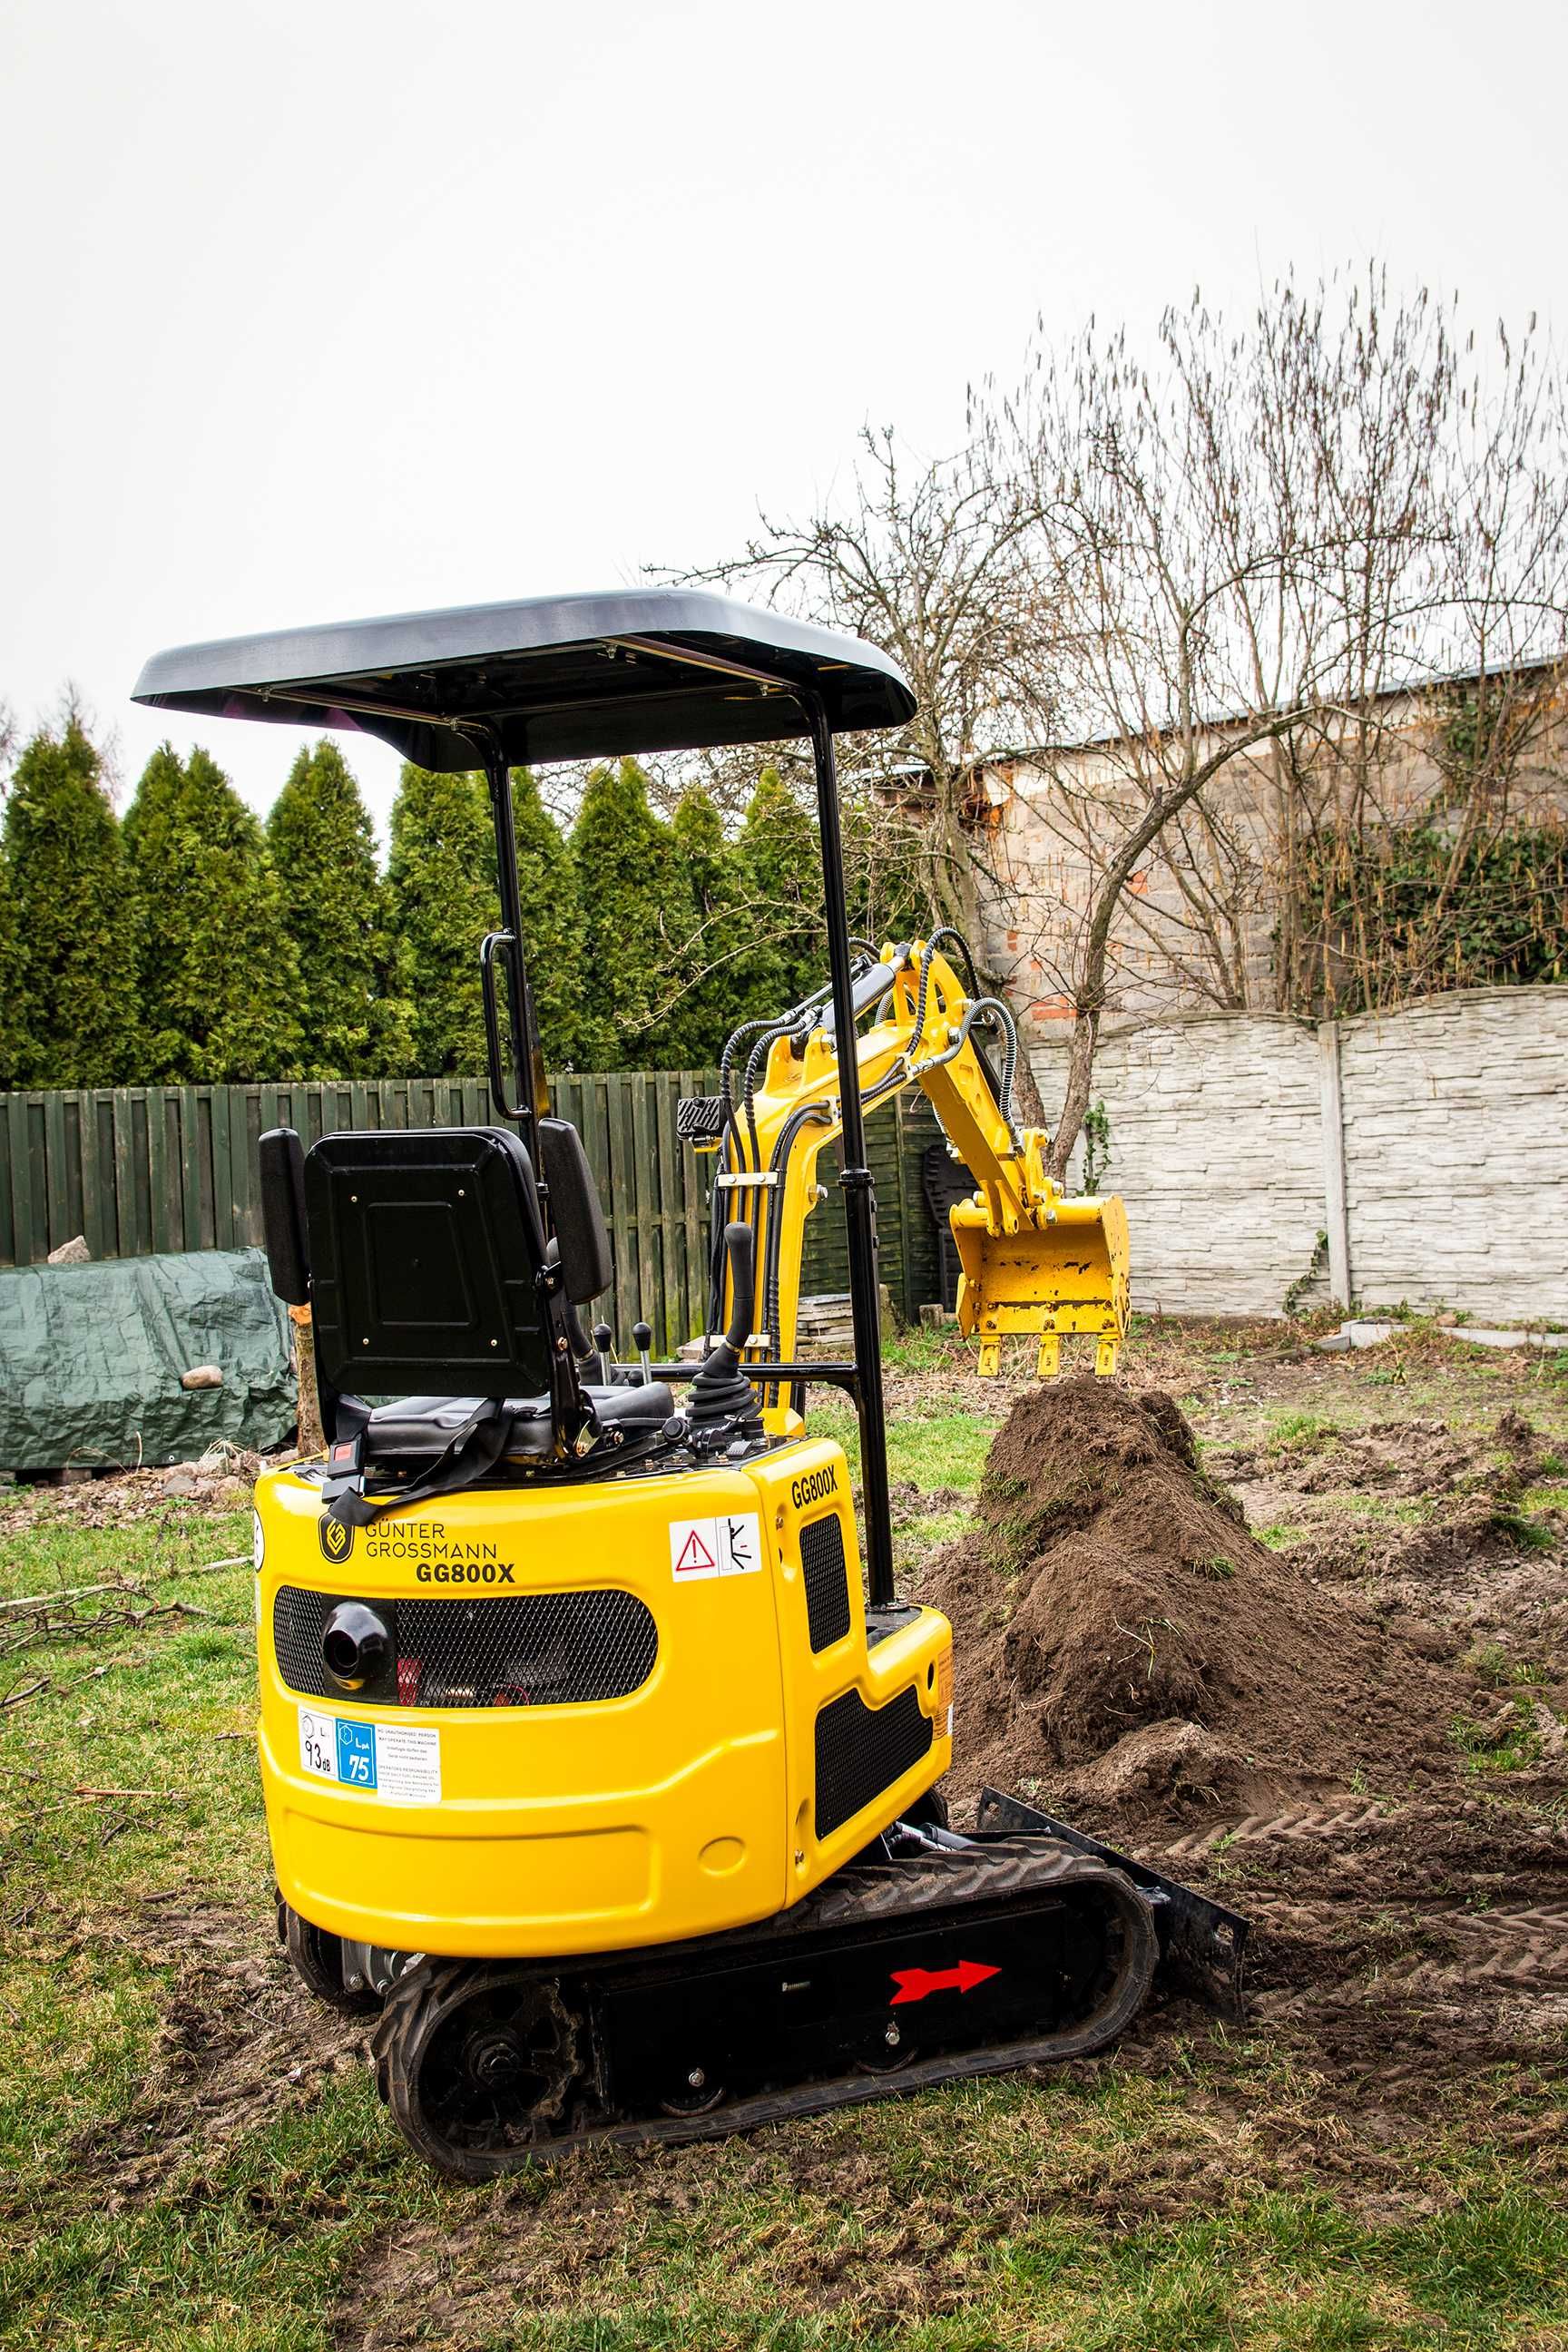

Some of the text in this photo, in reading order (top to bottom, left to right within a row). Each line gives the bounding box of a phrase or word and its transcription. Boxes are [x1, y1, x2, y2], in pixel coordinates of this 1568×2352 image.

[792, 1465, 838, 1509] GG800X
[365, 1518, 445, 1538] GÜNTER
[366, 1543, 496, 1559] GROSSMANN
[416, 1563, 515, 1583] GG800X
[349, 1754, 369, 1781] 75
